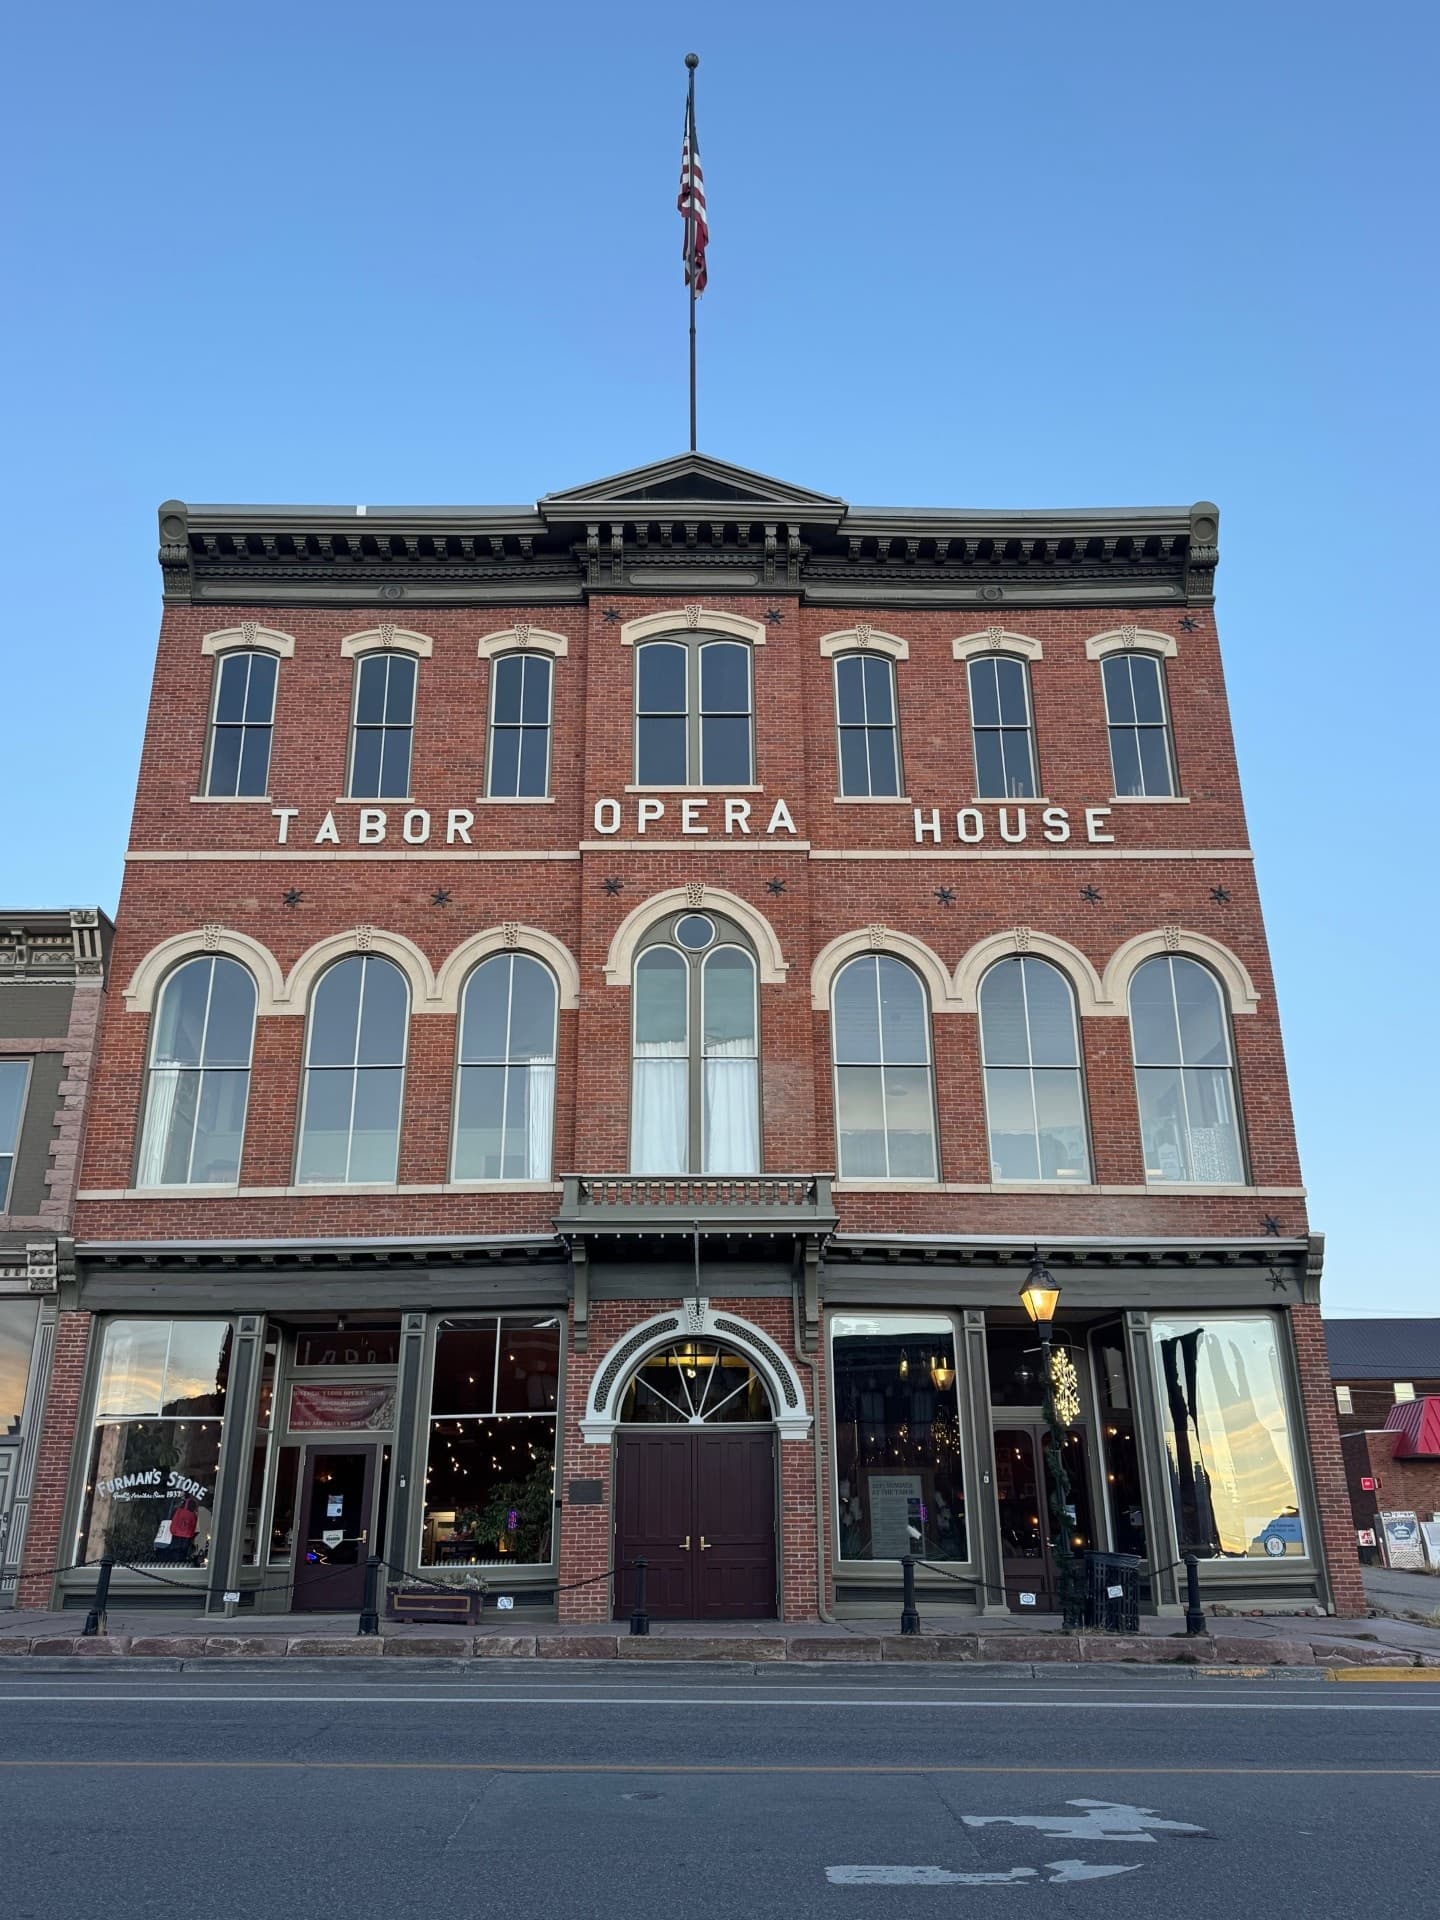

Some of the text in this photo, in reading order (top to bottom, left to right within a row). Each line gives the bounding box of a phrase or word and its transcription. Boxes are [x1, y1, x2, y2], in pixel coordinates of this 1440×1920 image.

[272, 799, 1115, 844] TABOR OPERA HOUSE
[97, 1468, 209, 1501] FURMAN'S STORE
